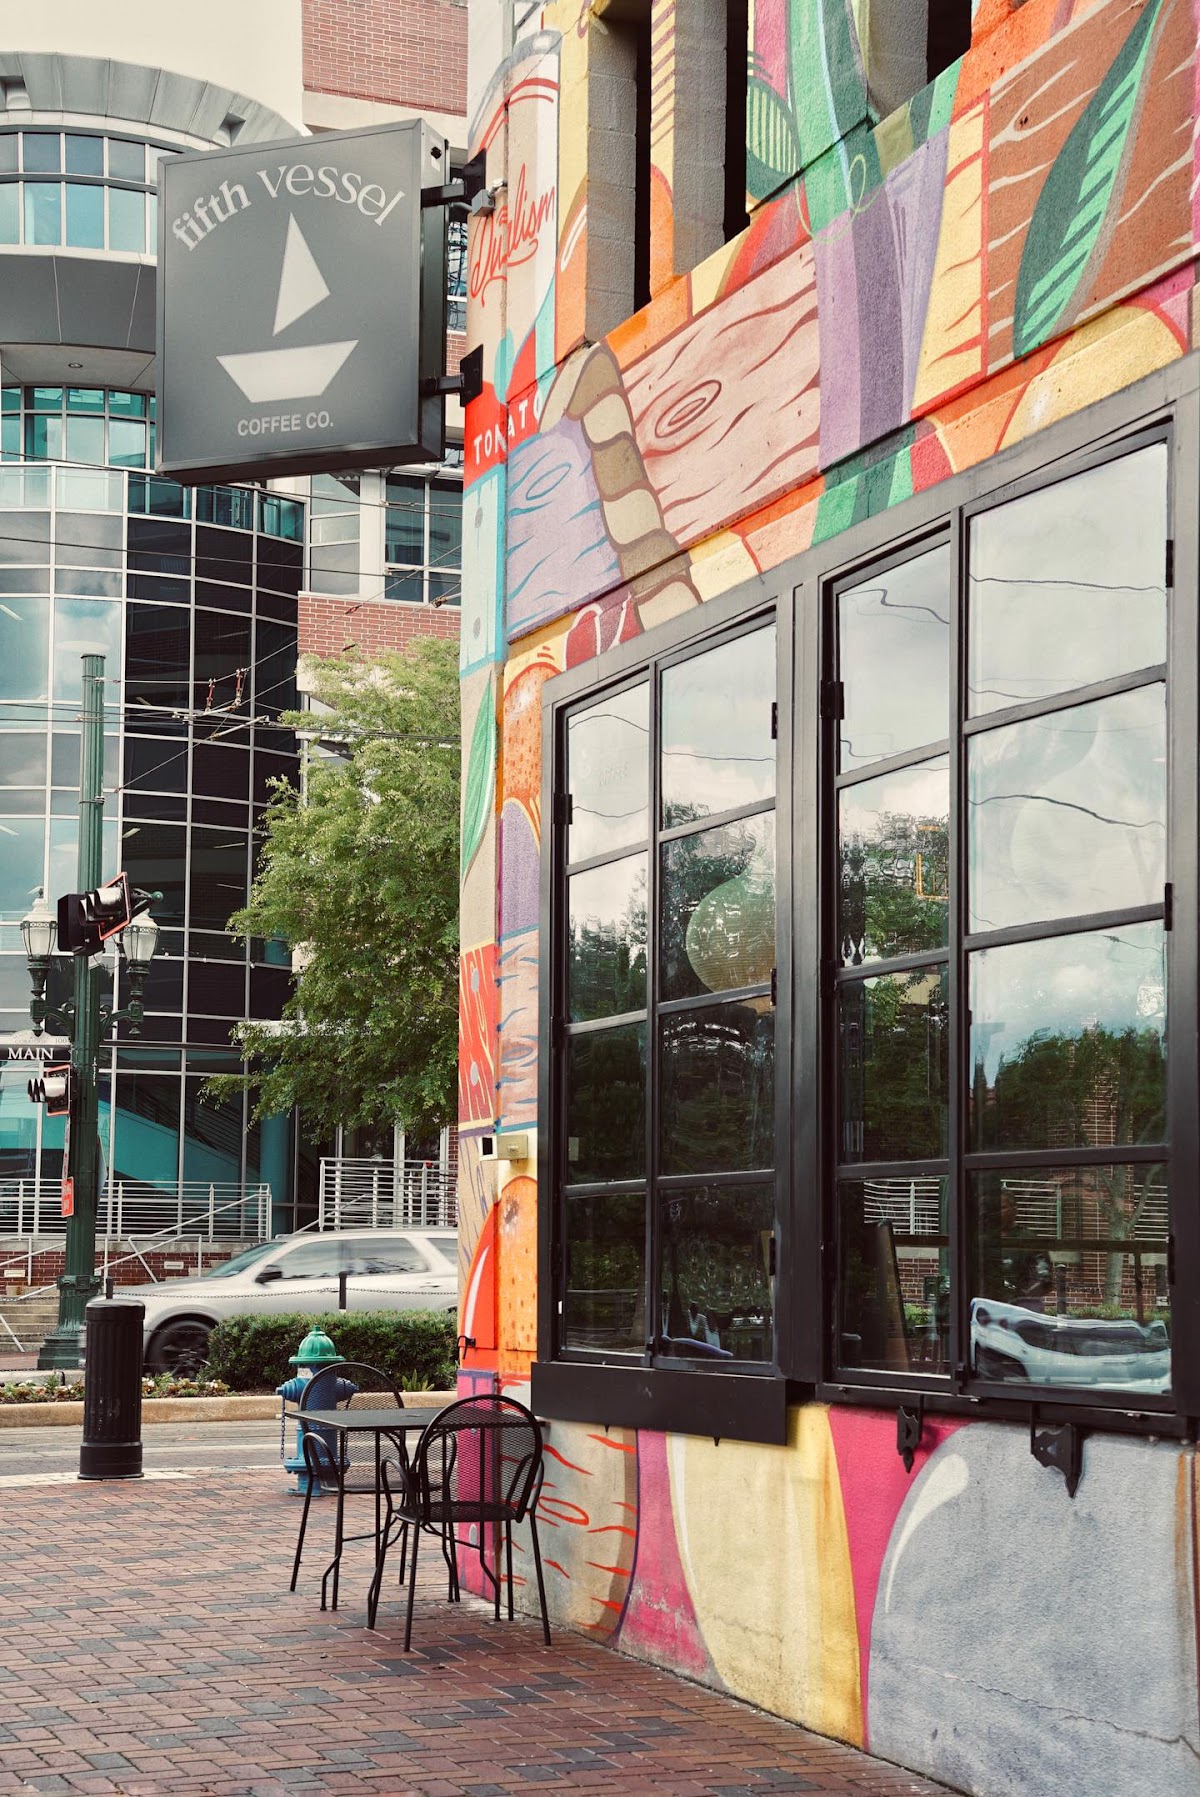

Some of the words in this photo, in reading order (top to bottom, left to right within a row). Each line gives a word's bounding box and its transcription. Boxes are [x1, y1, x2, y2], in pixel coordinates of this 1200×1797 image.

[172, 180, 252, 252] fifth
[256, 164, 406, 227] vessel
[237, 413, 302, 437] COFFEE
[305, 410, 334, 430] CO.
[7, 1047, 54, 1060] MAIN
